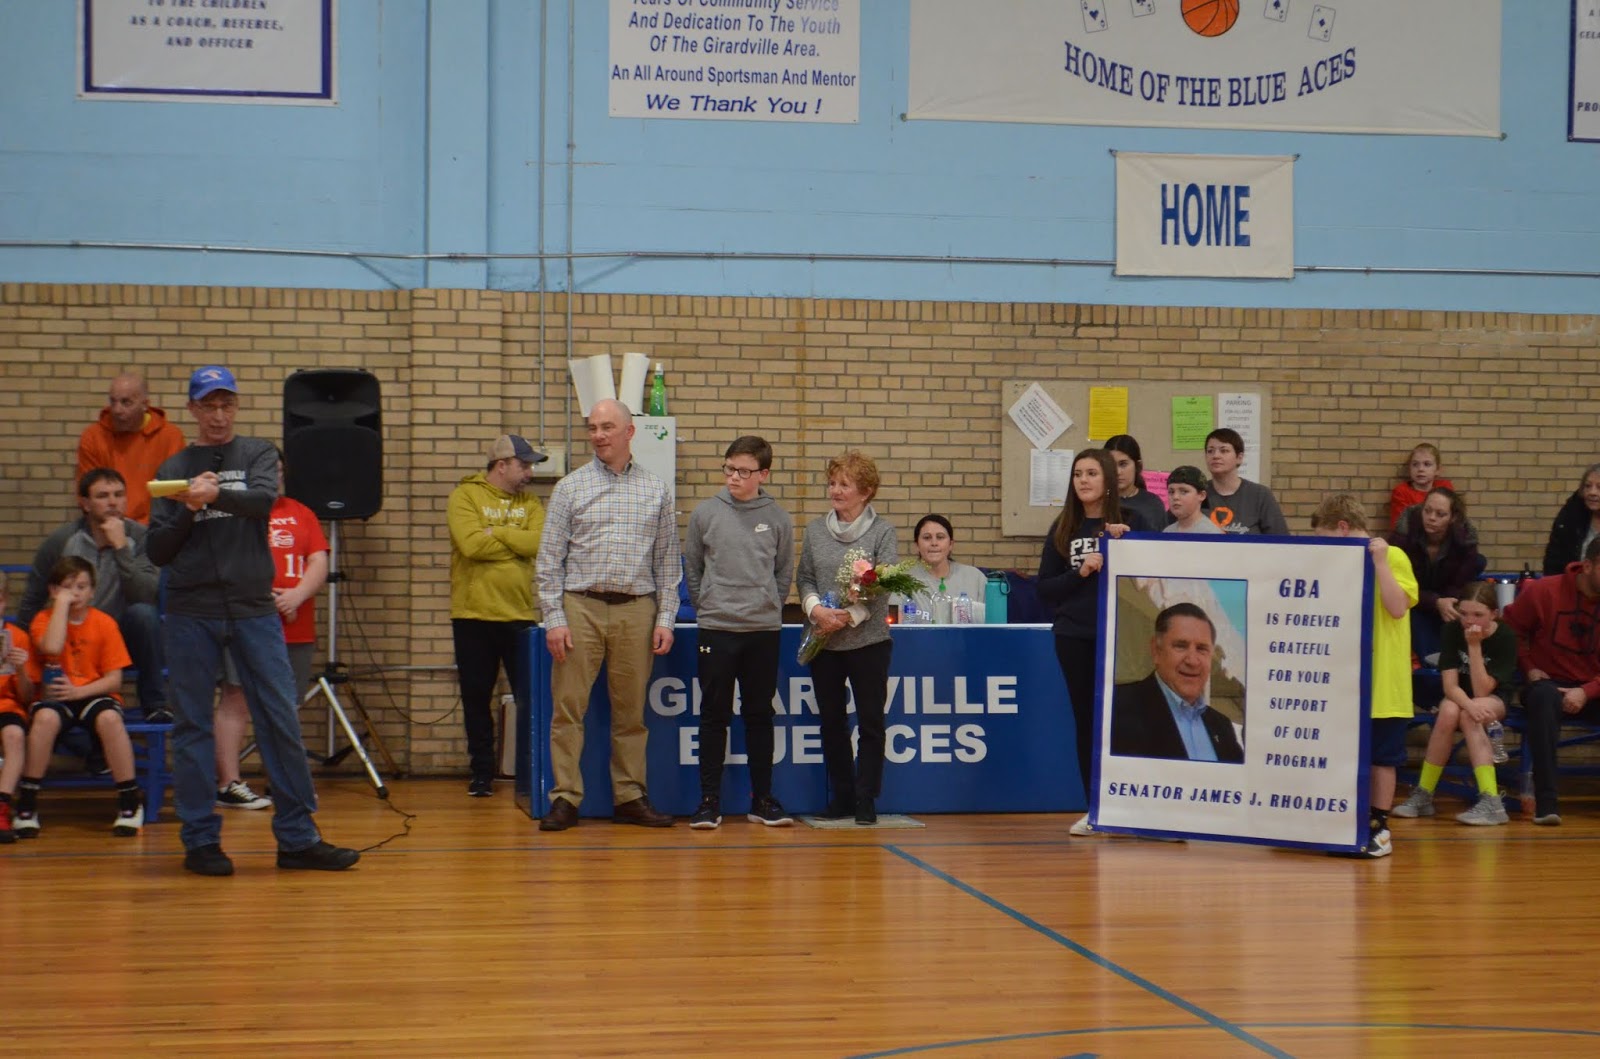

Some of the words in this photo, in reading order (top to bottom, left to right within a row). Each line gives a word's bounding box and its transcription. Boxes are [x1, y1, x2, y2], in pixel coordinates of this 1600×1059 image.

[130, 15, 148, 26] AS
[153, 16, 161, 26] A
[166, 17, 217, 29] COACH,
[222, 18, 284, 31] REFEREE,
[628, 11, 659, 28] And
[663, 12, 742, 31] Dedication
[747, 14, 764, 32] To
[770, 15, 795, 33] The
[800, 17, 841, 34] Youth
[166, 36, 193, 47] AND
[198, 38, 254, 49] OFFICER
[650, 35, 668, 52] Of
[672, 35, 698, 53] The
[703, 36, 779, 56] Girardville
[783, 39, 820, 57] Area.
[611, 64, 630, 80] An
[633, 65, 651, 81] All
[655, 65, 703, 82] Around
[707, 66, 778, 87] Sportsman
[781, 69, 808, 86] And
[812, 70, 856, 87] Mentor
[1064, 41, 1133, 97] HOME
[1139, 70, 1170, 103] OF
[1175, 75, 1222, 107] THE
[1227, 72, 1287, 107] BLUE
[1297, 46, 1357, 97] ACES
[646, 94, 681, 111] We
[690, 95, 757, 113] Thank
[767, 97, 807, 114] You
[1161, 183, 1251, 247] HOME
[1278, 578, 1321, 599] GBA
[1265, 612, 1280, 626] IS
[1284, 613, 1341, 628] FOREVER
[1268, 641, 1332, 656] GRATEFUL
[1267, 669, 1292, 683] FOR
[1297, 670, 1331, 684] YOUR
[1269, 697, 1329, 713] SUPPORT
[1273, 725, 1290, 739] OF
[1294, 727, 1321, 741] OUR
[850, 723, 988, 764] CES
[1265, 753, 1329, 770] PROGRAM
[1107, 782, 1184, 801] SENATOR
[1189, 787, 1243, 805] JAMES
[1249, 792, 1263, 807] J.
[1269, 793, 1349, 814] RHOADES
